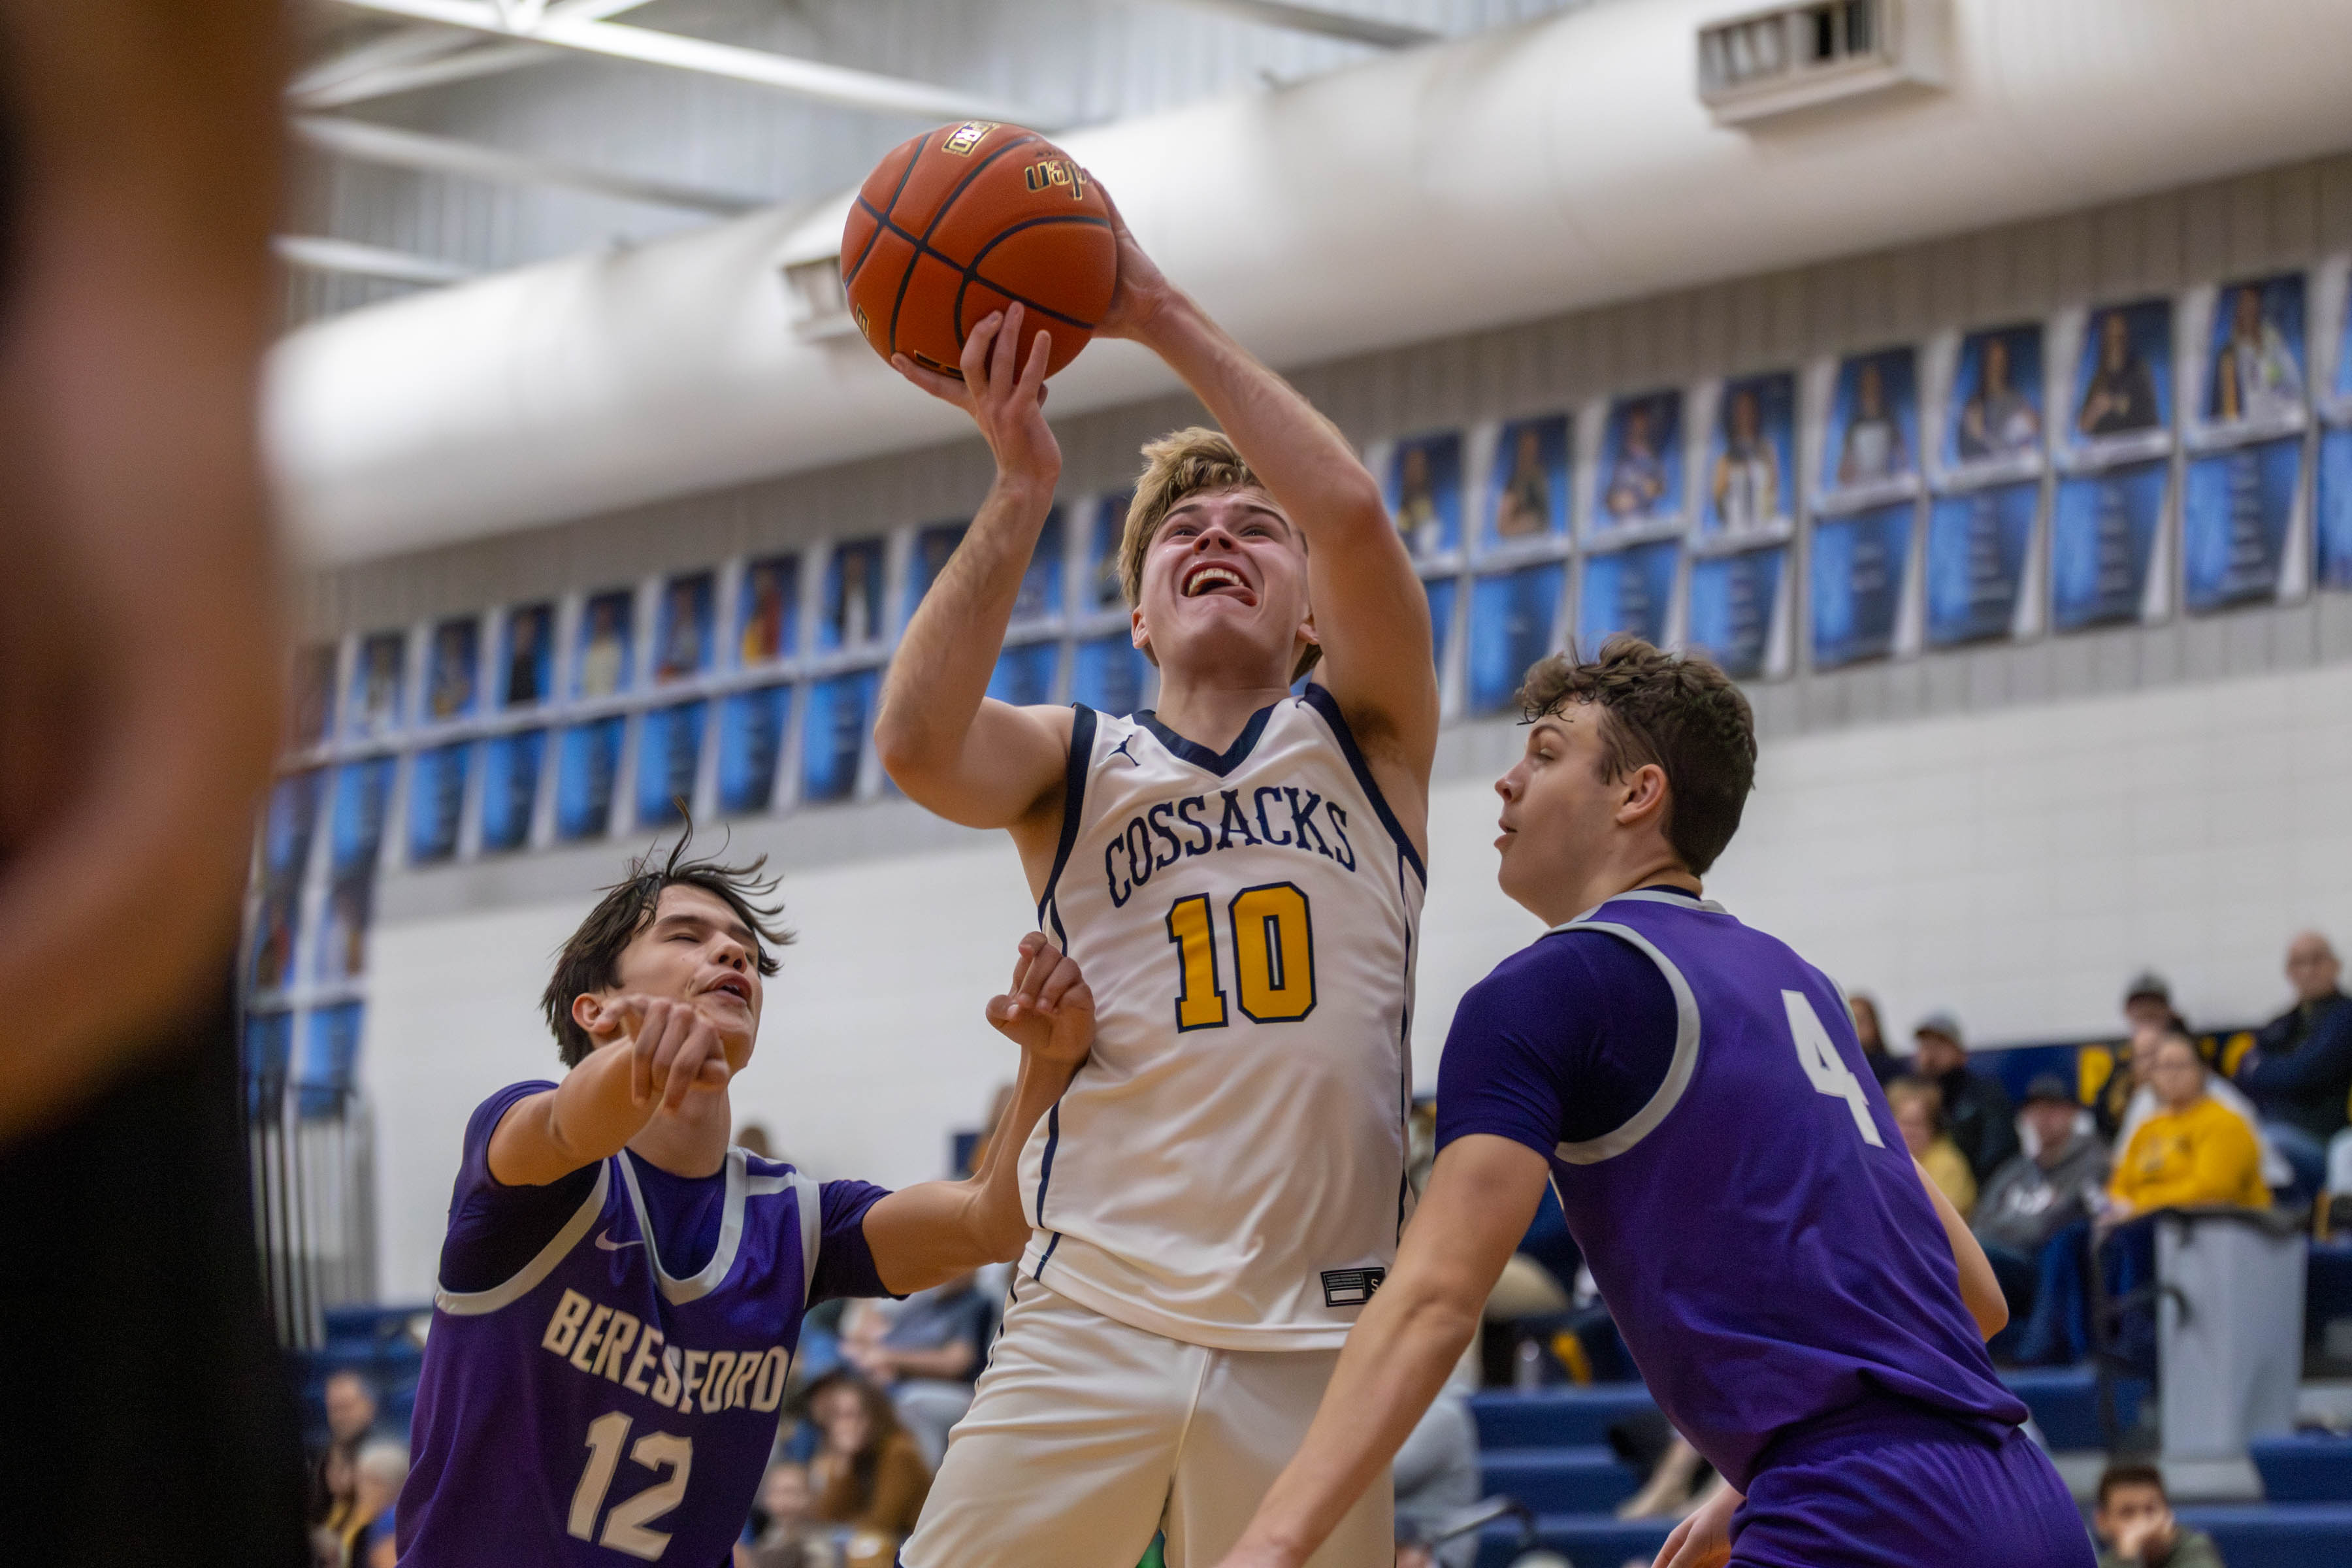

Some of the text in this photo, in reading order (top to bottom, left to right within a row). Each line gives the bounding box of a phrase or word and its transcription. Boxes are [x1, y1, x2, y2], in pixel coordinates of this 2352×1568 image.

[1105, 786, 1356, 908] COSSACKS
[1165, 881, 1317, 1034] 10
[1780, 988, 1886, 1149] 4
[541, 1287, 789, 1414] BERESFORD
[566, 1410, 694, 1561] 12
